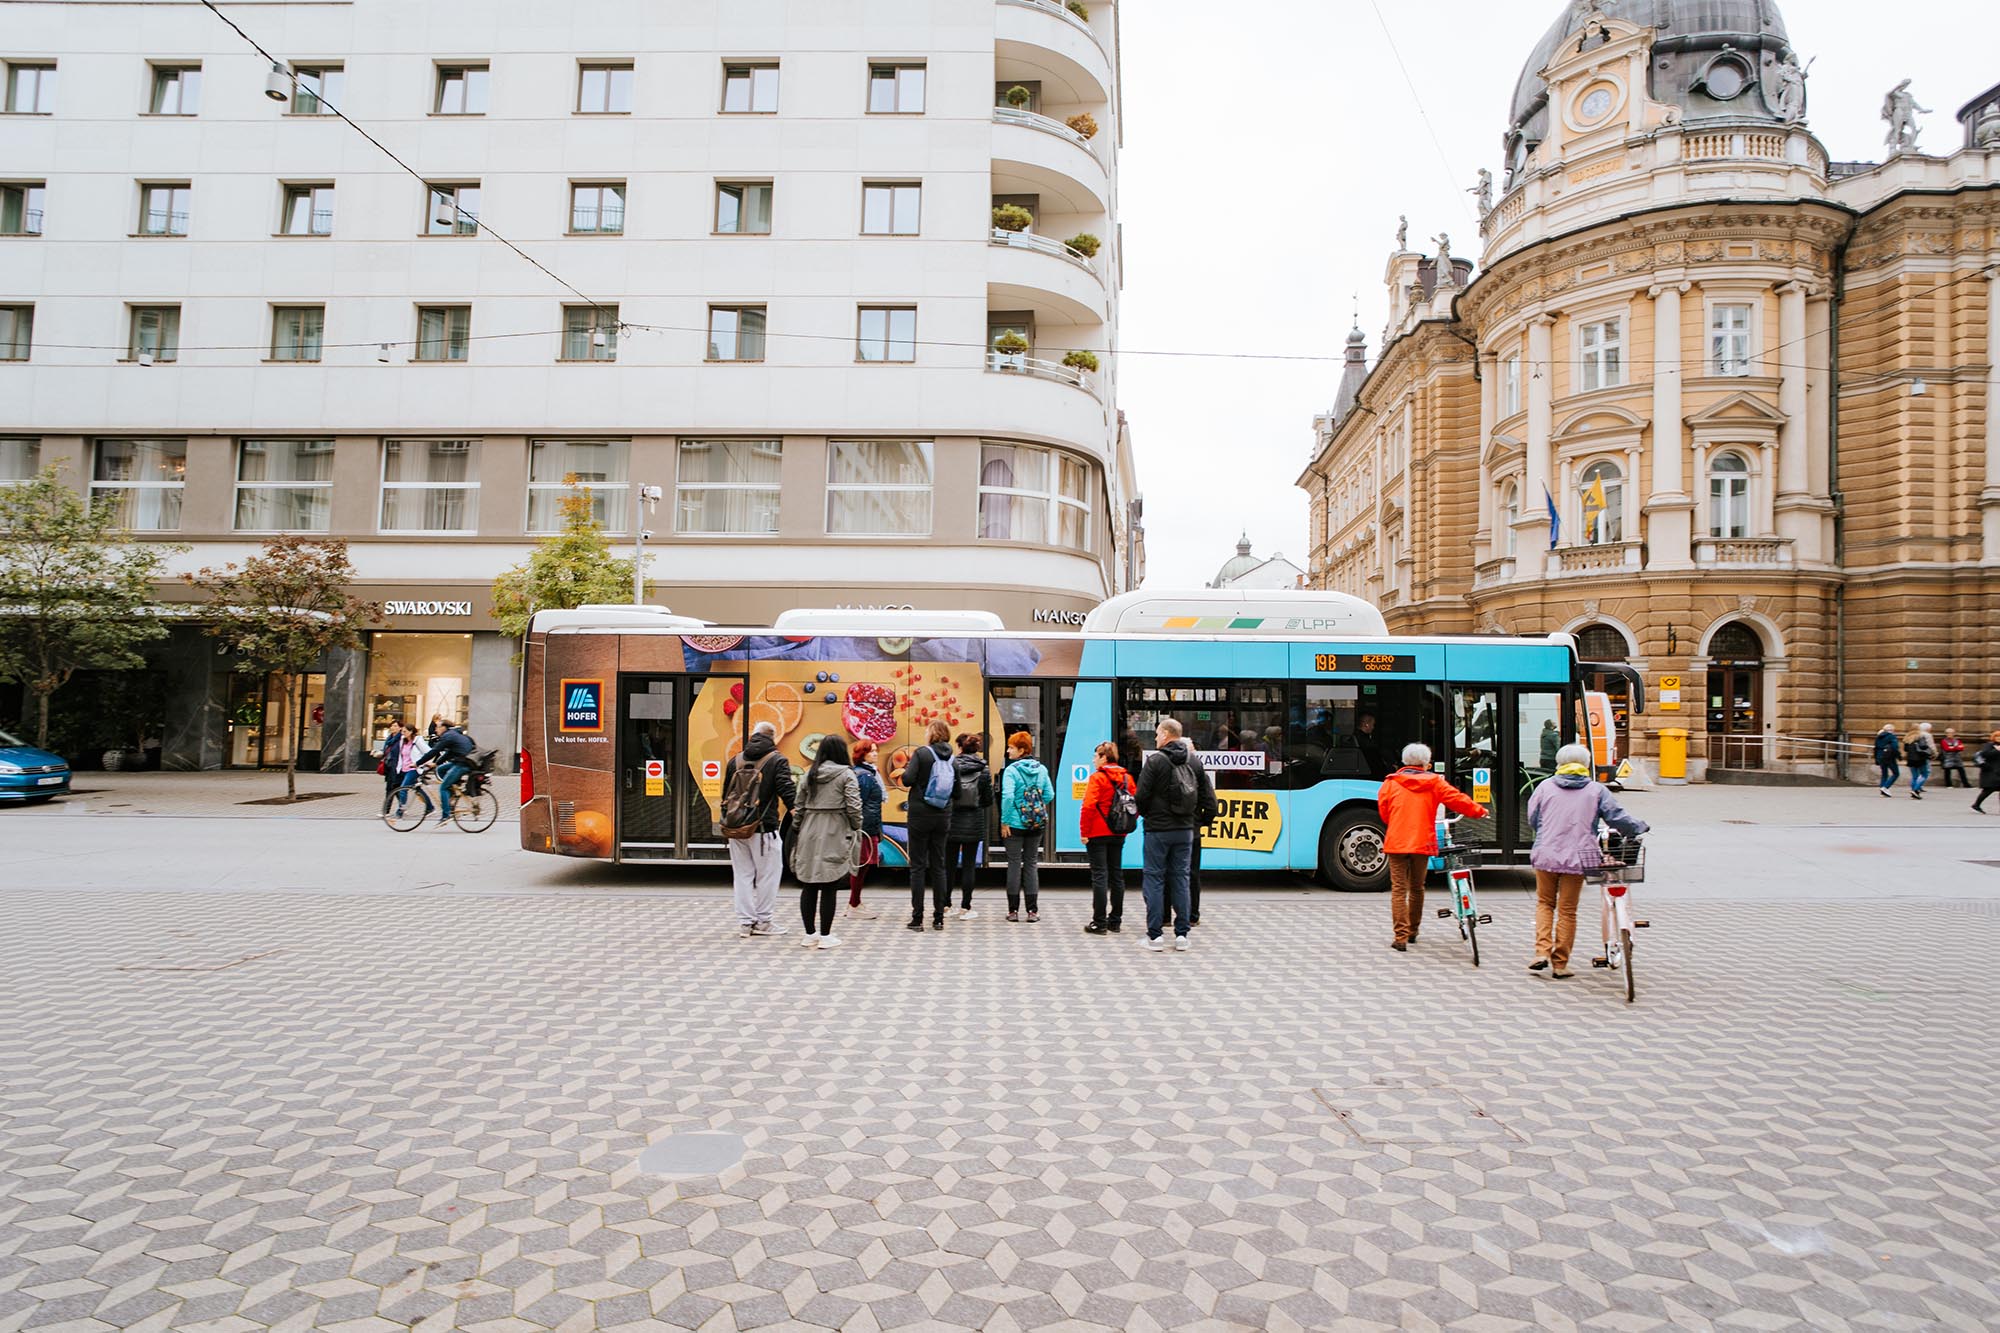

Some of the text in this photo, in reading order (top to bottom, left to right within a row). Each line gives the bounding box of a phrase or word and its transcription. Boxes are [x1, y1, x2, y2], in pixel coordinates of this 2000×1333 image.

[384, 600, 472, 616] SWAROVSKI
[1302, 619, 1336, 630] LPP
[1361, 654, 1394, 663] JEZERO
[567, 712, 597, 721] HOFER
[1216, 799, 1269, 820] OFER
[1201, 821, 1263, 844] ENA,-
